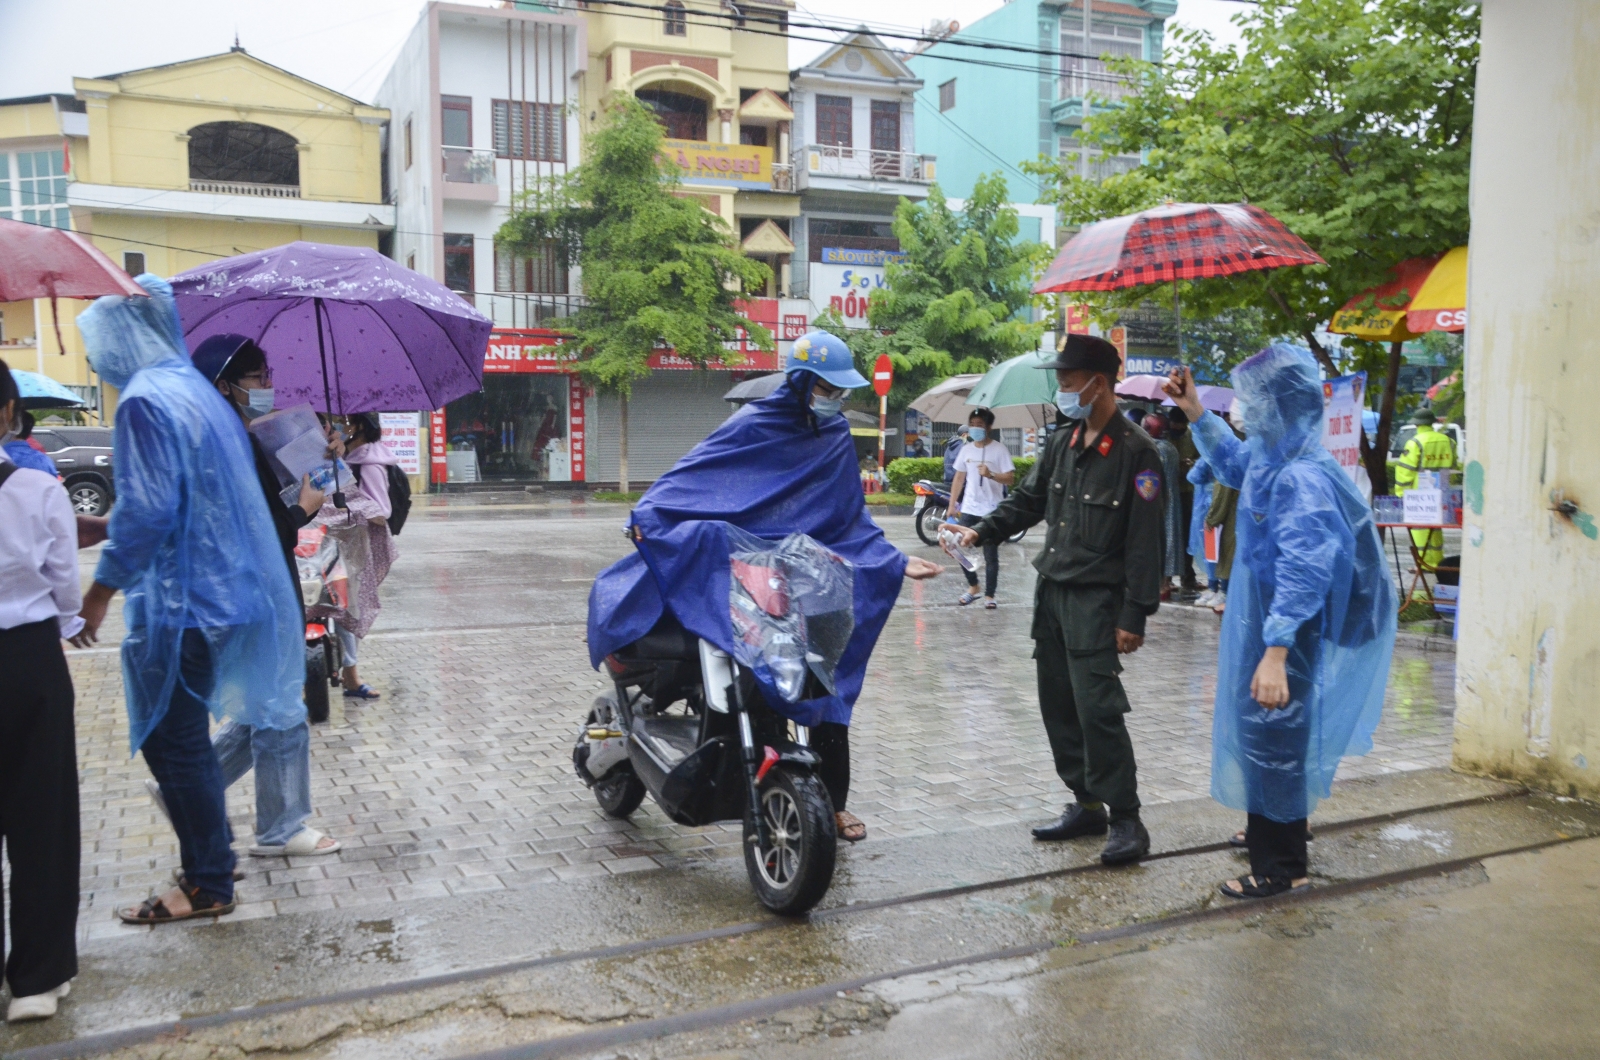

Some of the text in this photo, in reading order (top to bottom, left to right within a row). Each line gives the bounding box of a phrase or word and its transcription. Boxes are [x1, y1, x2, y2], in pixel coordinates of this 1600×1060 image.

[696, 154, 760, 175] NGHỈ
[786, 317, 804, 325] UNI
[786, 328, 805, 338] QLO
